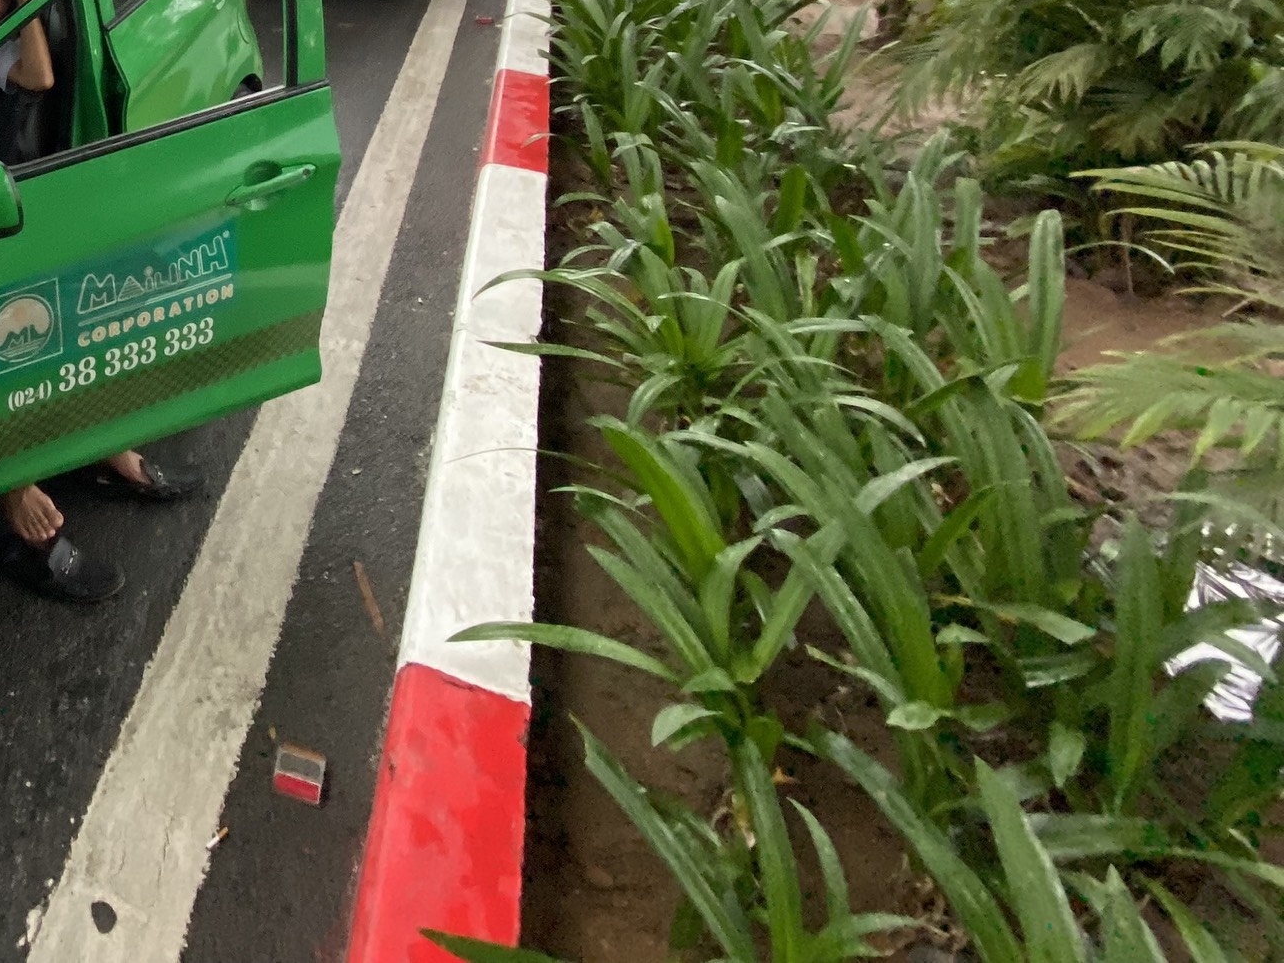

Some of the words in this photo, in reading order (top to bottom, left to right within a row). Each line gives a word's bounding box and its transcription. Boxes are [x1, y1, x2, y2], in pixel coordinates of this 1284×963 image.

[77, 283, 234, 347] CORPORATION
[8, 379, 53, 412] (024)
[58, 356, 97, 392] 38
[104, 336, 157, 377] 333
[163, 317, 214, 356] 333
